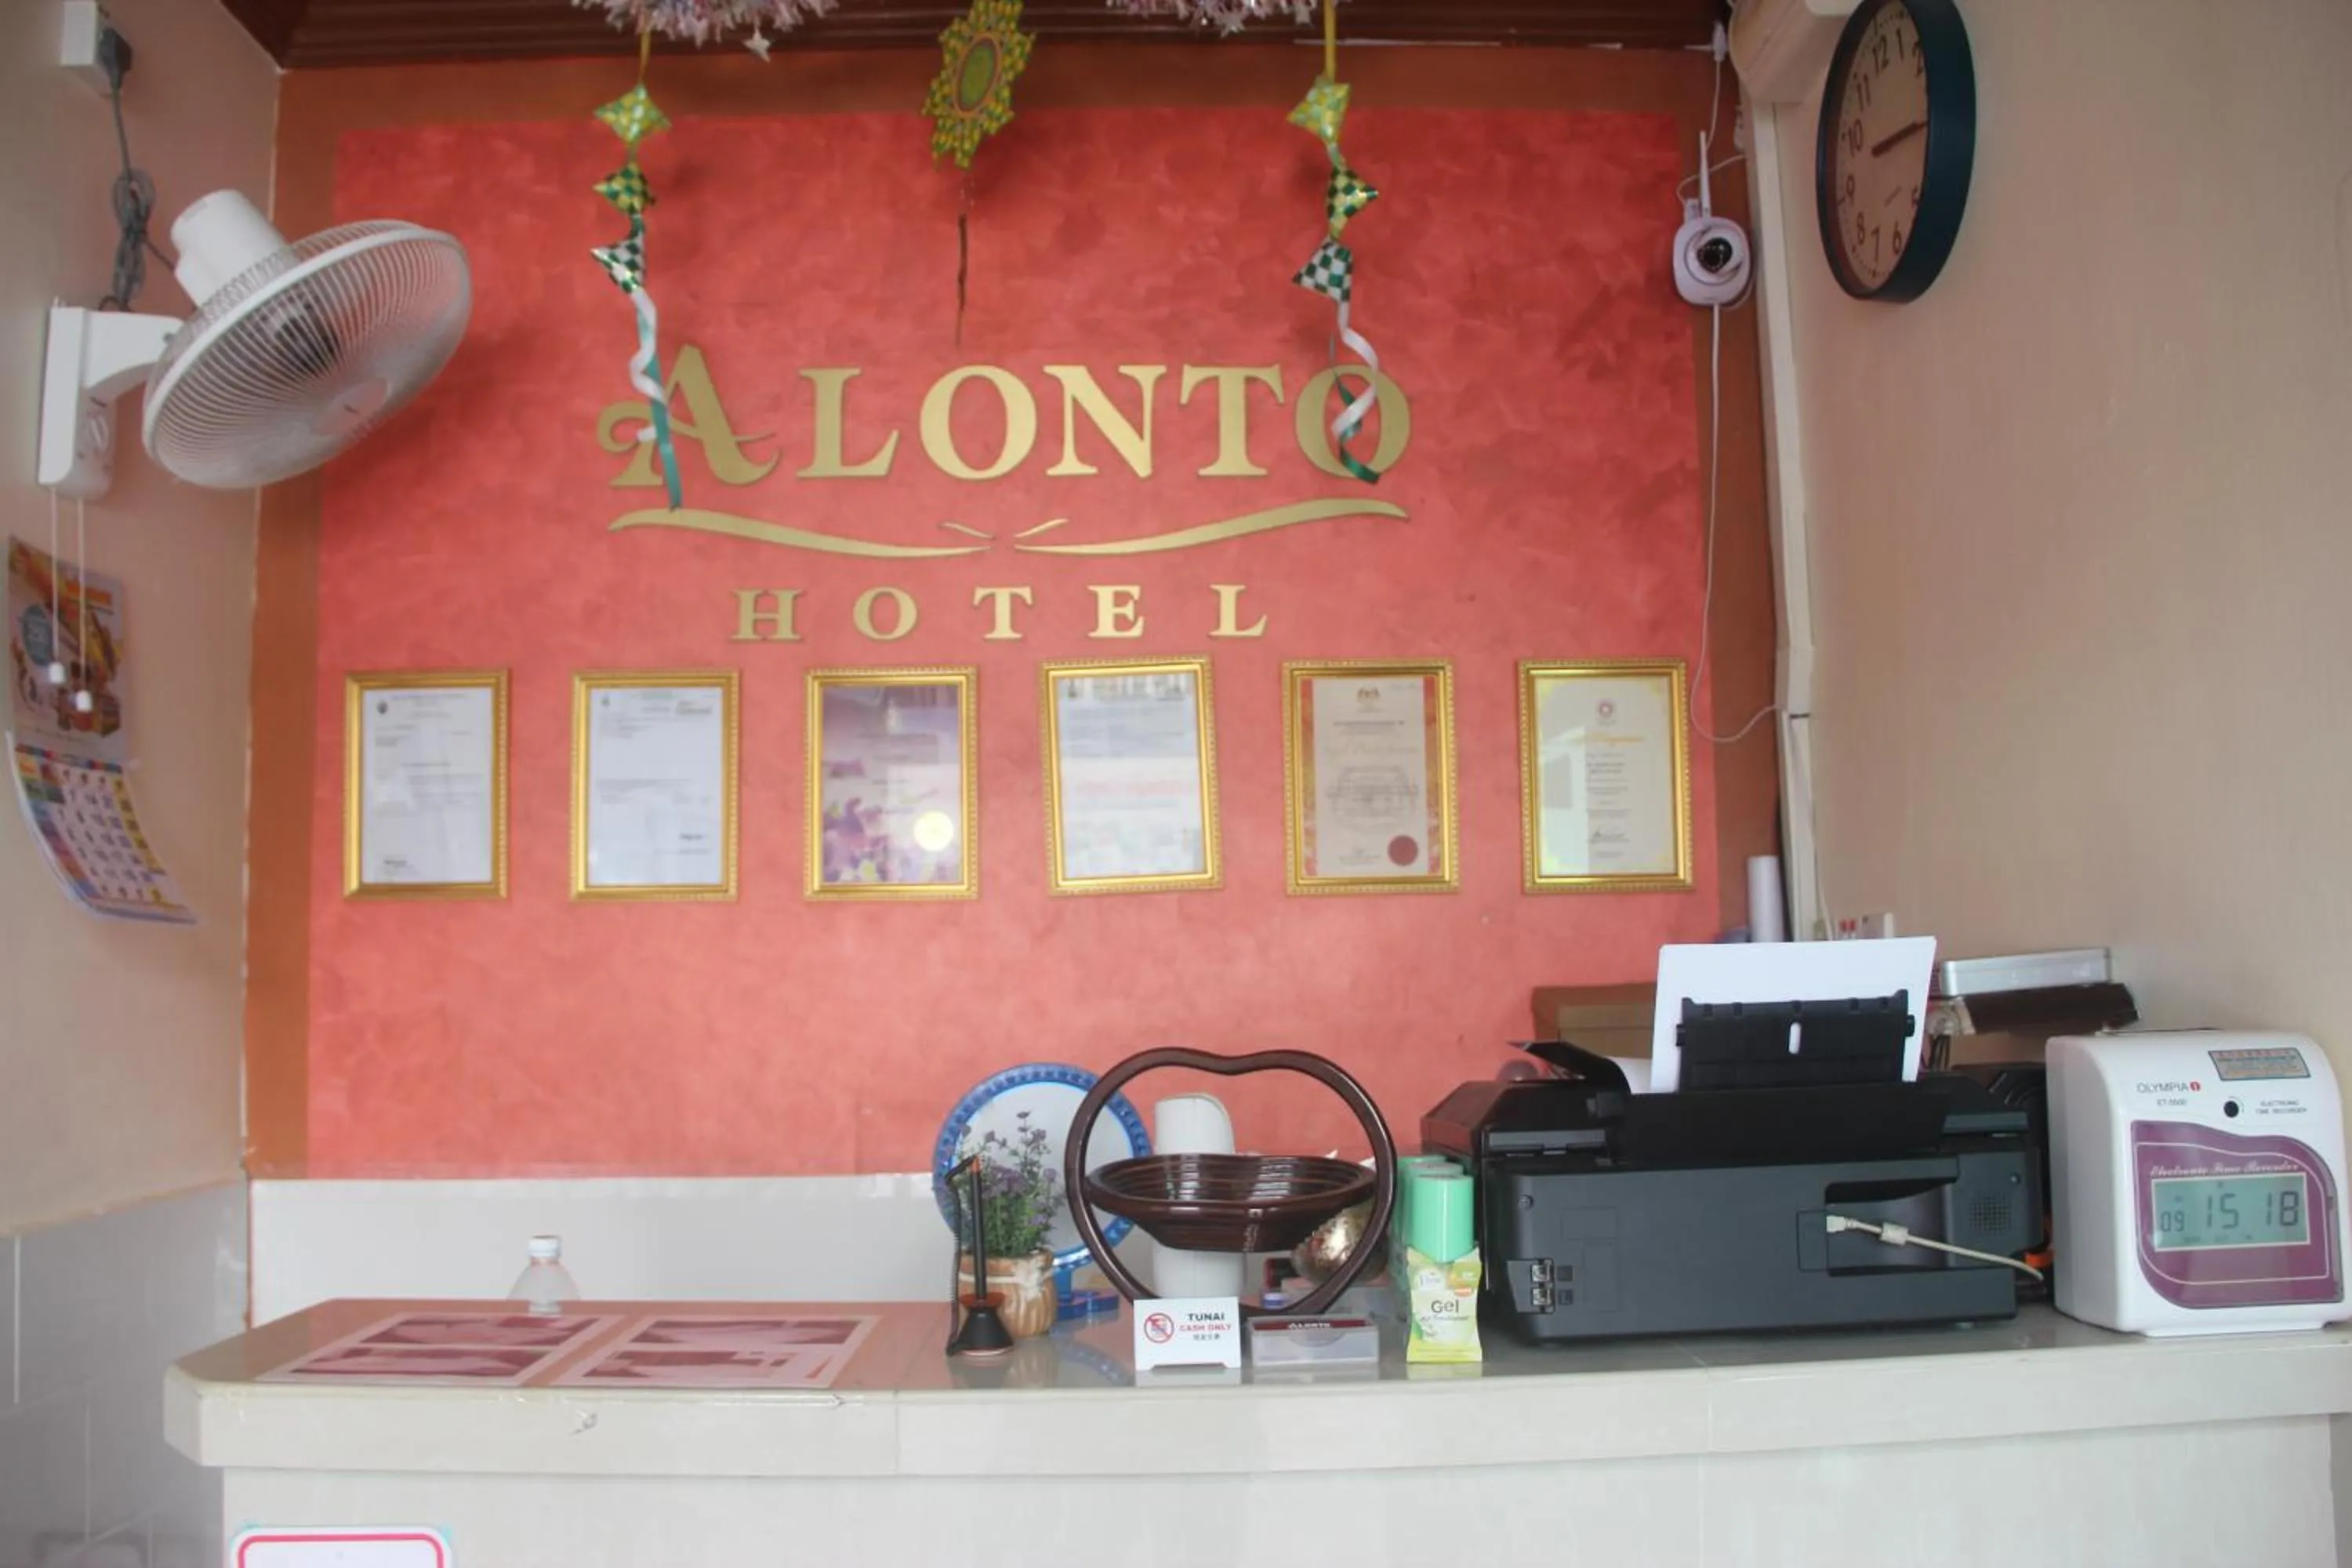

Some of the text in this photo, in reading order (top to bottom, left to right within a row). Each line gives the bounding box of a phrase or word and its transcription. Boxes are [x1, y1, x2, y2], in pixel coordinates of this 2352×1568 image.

[1872, 34, 1889, 76] 12
[1856, 73, 1871, 111] 11
[1848, 118, 1863, 156] 10
[1846, 174, 1855, 206] 9
[1857, 211, 1865, 245] 8
[1871, 226, 1880, 263] 7
[1892, 222, 1902, 255] 6
[597, 344, 1410, 488] ALONTO
[731, 583, 1267, 641] HOTEL
[2136, 1082, 2189, 1093] OLYMPIA
[2161, 1190, 2299, 1232] 09 15 18
[1187, 1312, 1225, 1321] TUNAI
[1431, 1299, 1460, 1313] Gel
